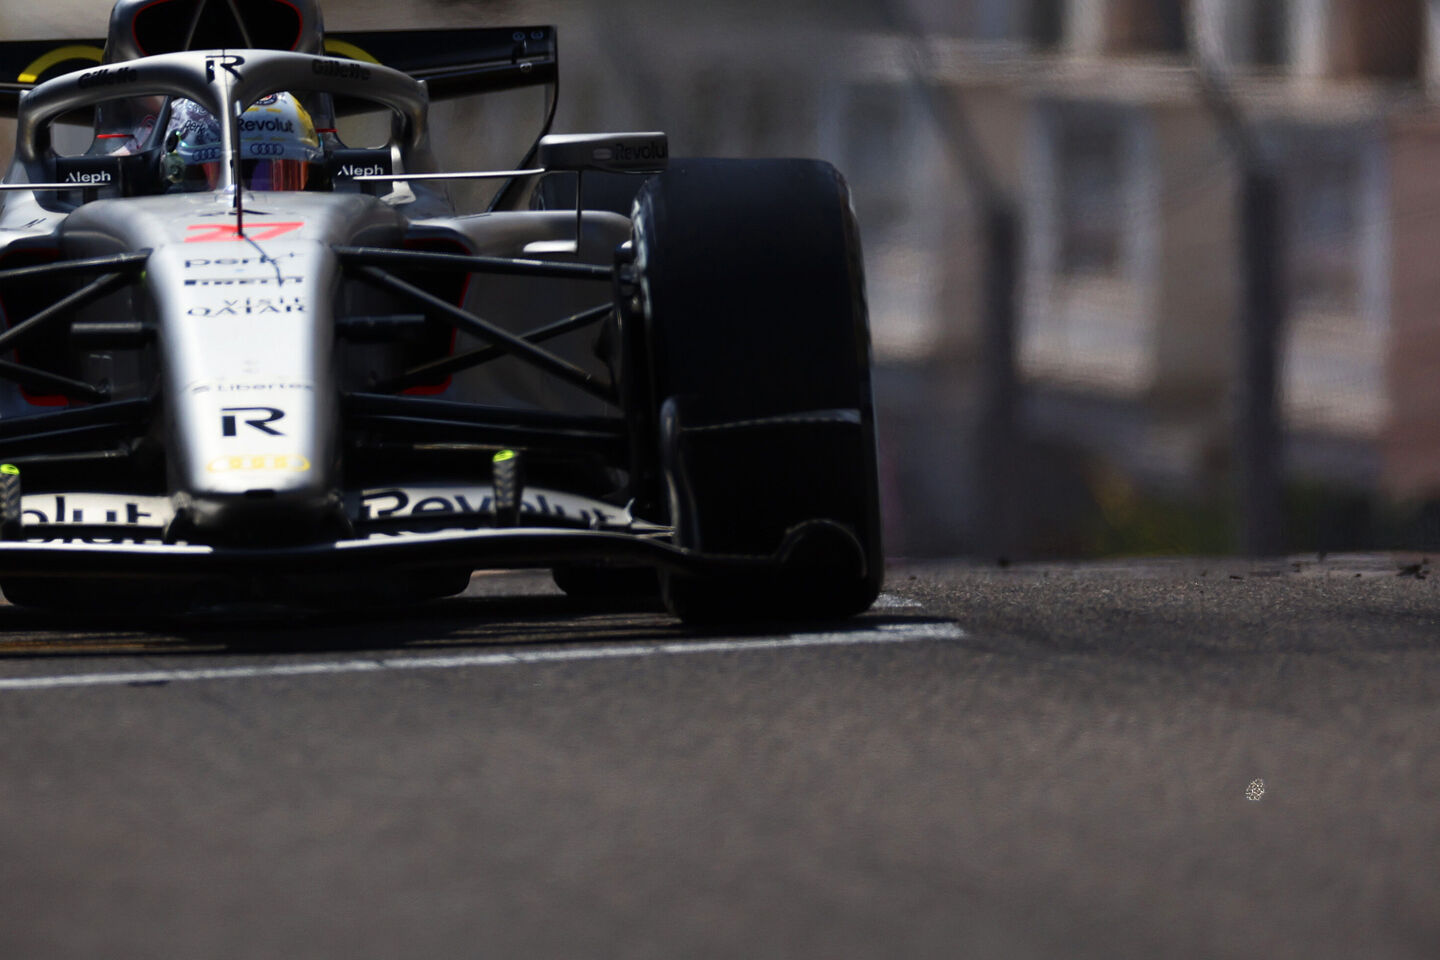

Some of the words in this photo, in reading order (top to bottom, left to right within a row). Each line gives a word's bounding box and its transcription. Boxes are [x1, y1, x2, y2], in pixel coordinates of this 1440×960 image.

[78, 67, 138, 88] Gillette
[205, 54, 245, 85] R
[311, 59, 372, 81] Gillette
[65, 171, 111, 184] Aleph
[337, 164, 384, 177] Aleph
[184, 222, 305, 243] 27
[220, 406, 288, 437] R
[360, 490, 616, 523] Revlut
